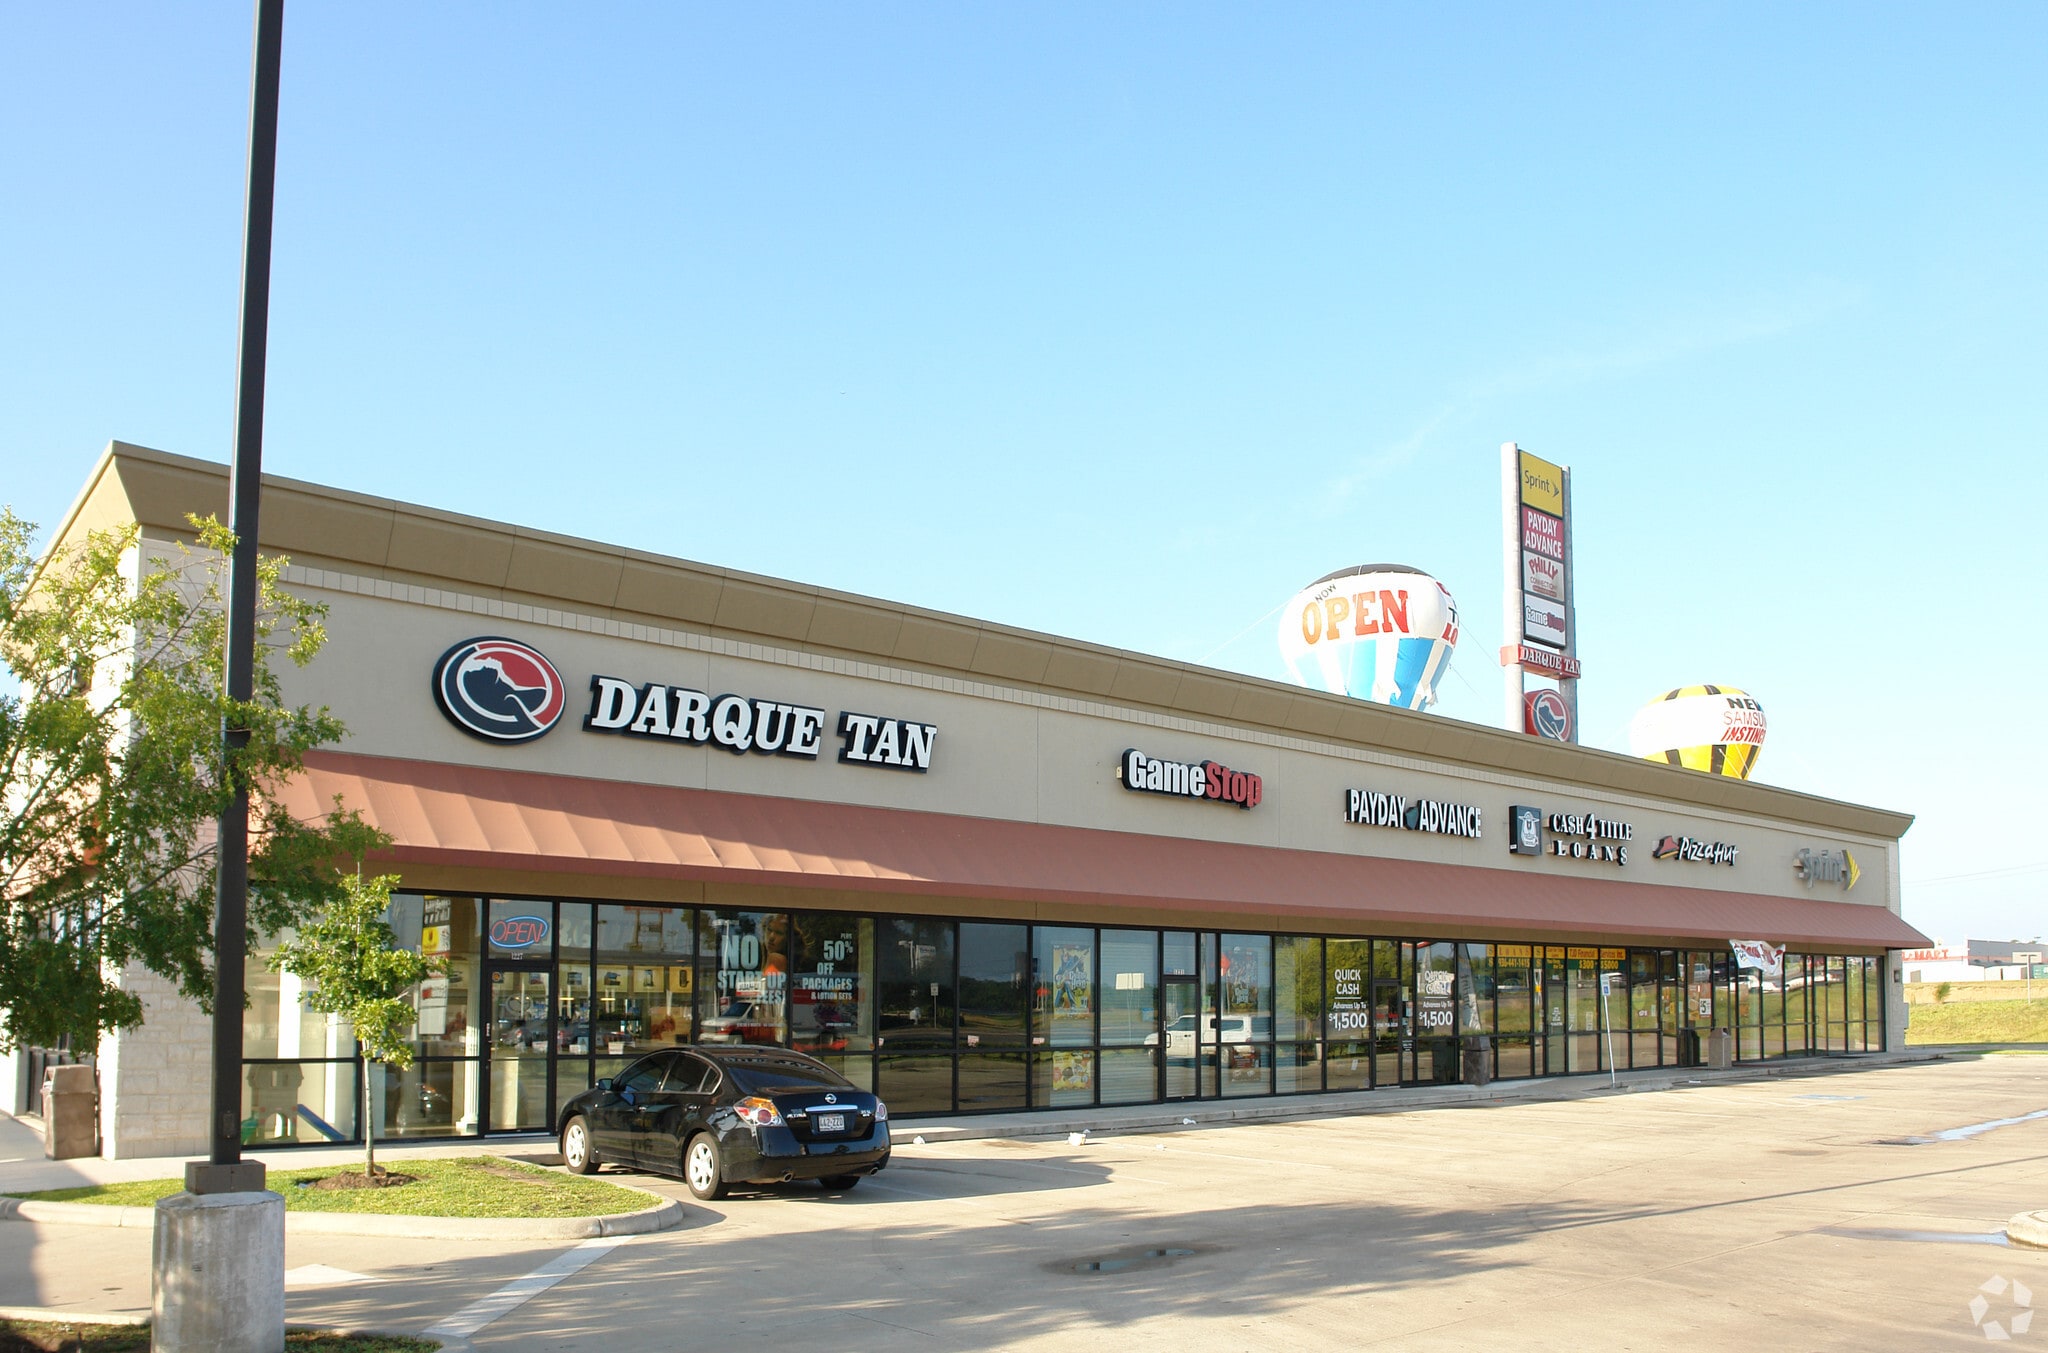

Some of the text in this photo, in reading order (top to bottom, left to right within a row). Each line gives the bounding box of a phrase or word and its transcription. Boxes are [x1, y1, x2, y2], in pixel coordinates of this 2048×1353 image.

[1524, 470, 1550, 493] Sprint
[1528, 511, 1558, 537] PAYDAY
[1525, 530, 1562, 558] ADVANCE
[1528, 556, 1559, 580] PHILLY
[1315, 584, 1337, 603] NOW
[1302, 589, 1410, 645] OPEN
[1520, 647, 1562, 669] DARQUE
[591, 677, 937, 768] DARQUE TAN
[1128, 750, 1262, 807] GameStop
[1351, 788, 1482, 838] PAYDAY ADVANCE
[1586, 813, 1597, 840] 4
[1599, 819, 1633, 841] TITLE
[1557, 839, 1628, 865] LOANS
[1800, 848, 1843, 888] Sprint
[491, 920, 544, 943] OPEN
[721, 935, 759, 969] NO
[823, 940, 854, 961] 50%
[718, 970, 762, 989] START
[767, 971, 787, 989] UP
[817, 962, 834, 975] OFF
[1334, 969, 1361, 981] QUICK
[1425, 970, 1448, 982] QUICK
[802, 977, 852, 990] PACKAGES
[1336, 984, 1359, 995] CASH
[1426, 984, 1448, 995] CASH
[811, 992, 816, 1000] &
[818, 992, 837, 1000] LOTION
[1354, 1002, 1361, 1011] Up
[1329, 1012, 1367, 1031] $1,500
[1419, 1011, 1453, 1029] $1,500
